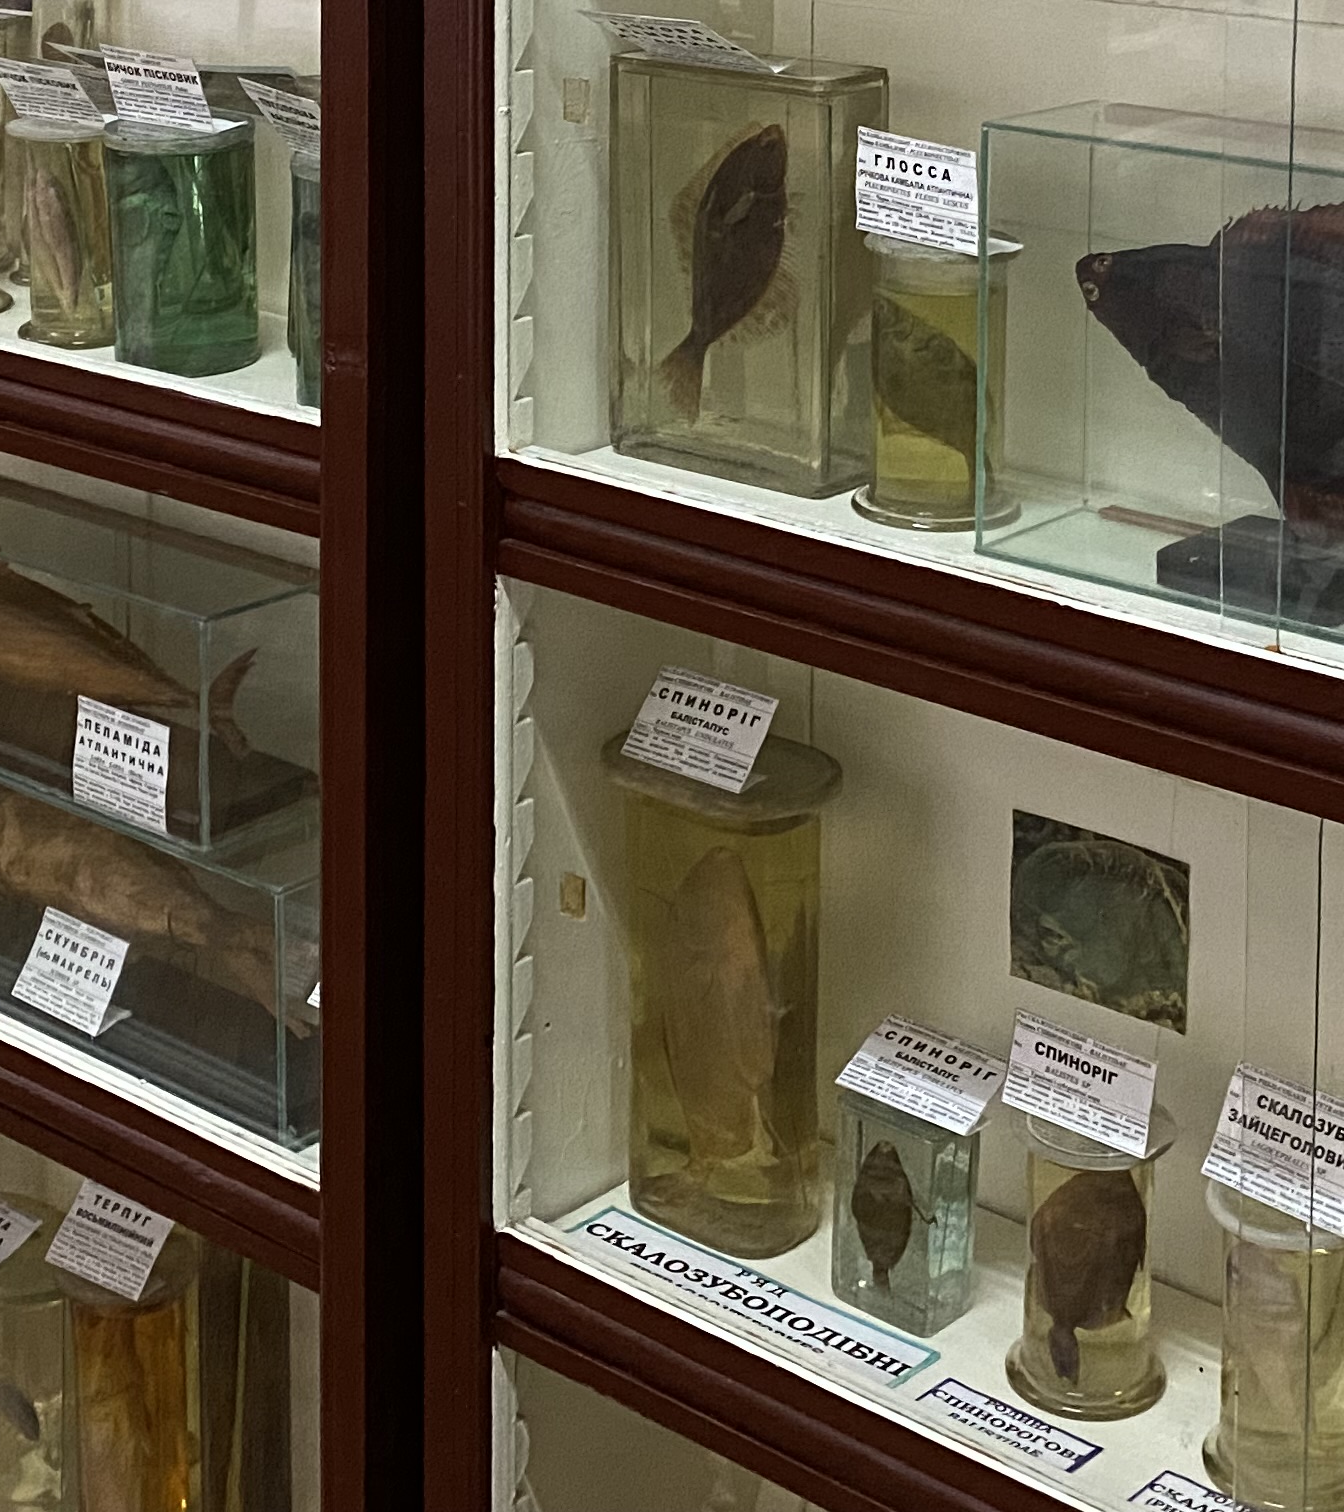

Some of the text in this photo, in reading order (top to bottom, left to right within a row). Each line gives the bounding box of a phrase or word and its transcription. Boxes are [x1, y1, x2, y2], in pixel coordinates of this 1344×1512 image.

[106, 61, 199, 86] БИЧОК ПІСКОВИК
[875, 154, 951, 181] ГЛОССА
[659, 688, 761, 727] СПИНОРІГ
[78, 735, 165, 777] АТЛАНТИЧНА
[84, 718, 162, 757] ПЕЛАМІДА
[45, 928, 115, 970] СКУМБРІЯ
[52, 953, 113, 991] МАКРЕЛЬ)
[885, 1030, 998, 1081] СПИНОРІГ
[1035, 1041, 1118, 1085] СПИНОРІГ
[93, 1194, 152, 1227] ТЕРПУГ
[586, 1222, 913, 1378] СКАЛОЗУБОПОДІБНІ
[735, 1267, 791, 1299] РЯД
